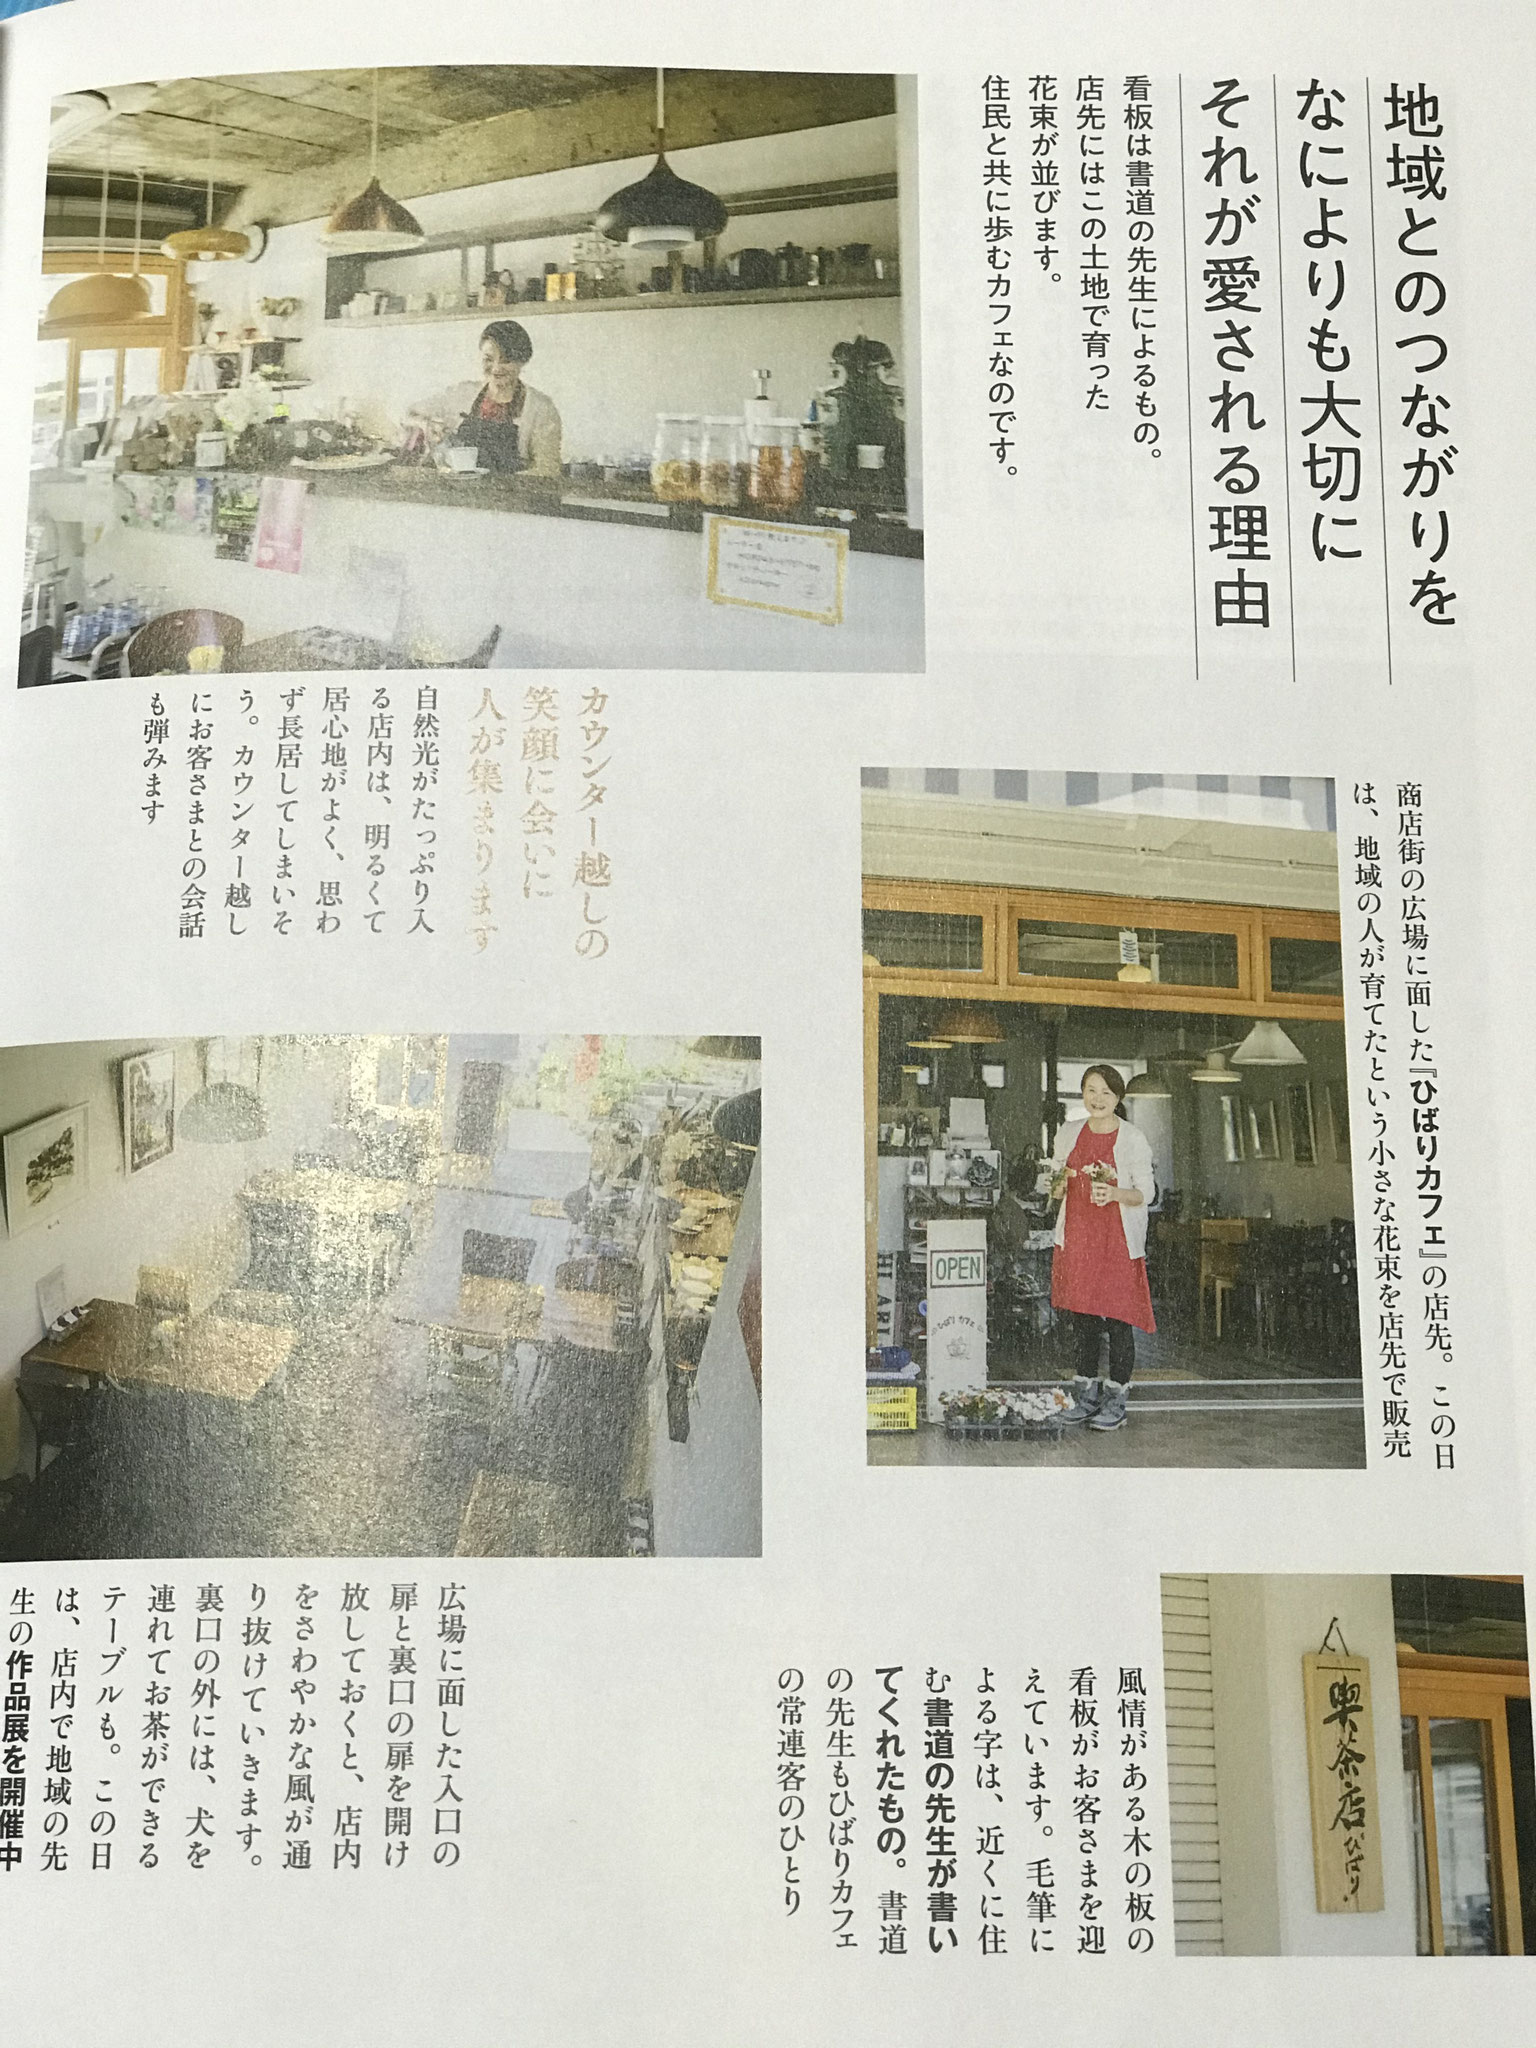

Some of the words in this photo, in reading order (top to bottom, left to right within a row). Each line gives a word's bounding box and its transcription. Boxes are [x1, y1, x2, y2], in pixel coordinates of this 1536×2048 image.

[982, 75, 1017, 475] 住民と共に歩むカフェなのです。
[1029, 75, 1061, 282] 花束が並びます。
[1076, 75, 1110, 409] 店先にはこの土地で育った
[1123, 75, 1161, 458] 看板は書道の先生によるもの。
[1297, 78, 1362, 561] なによりも大切に
[1201, 79, 1271, 628] それが愛される理由
[1384, 83, 1458, 625] 地域とのつながりを
[141, 693, 169, 824] も弾みます
[179, 694, 213, 938] にお客さまとの会話
[224, 689, 258, 935] う。カウンター越し
[271, 686, 306, 935] ず長居してしまいそ
[316, 687, 350, 933] 居心地がよく、思わ
[364, 688, 394, 933] る店内は、明るくて
[408, 685, 439, 934] 自然光がたっぷり入
[468, 688, 506, 953] 人が集まります
[521, 686, 559, 899] 笑顔に会いに
[572, 687, 611, 958] カウンター越しの
[1354, 783, 1411, 1457] は、地域の人が育てたという小さな花束を店先で販売
[1397, 782, 1455, 1469] 商店街の広場に面した『ひばりカフェ』の店先。この日
[935, 1256, 981, 1281] OPEN
[0, 1587, 35, 1871] 生の作品展を開催中
[41, 1588, 80, 1871] は、店内で地域の先
[91, 1587, 127, 1870] テーブルも。この日
[139, 1584, 176, 1868] 連れてお茶ができる
[186, 1583, 224, 1869] 裏口の外には、犬を
[236, 1583, 271, 1866] り抜けていきます。
[282, 1584, 318, 1869] をさわやかな風が通
[334, 1583, 370, 1869] 放しておくと、店内
[385, 1582, 418, 1868] 扉と裏口の扉を開け
[434, 1582, 467, 1867] 広場に面した入口の
[777, 1669, 806, 1916] の常連客のひとり
[826, 1669, 858, 1948] の先生もひばりカフェ
[875, 1666, 907, 1954] てくれたもの。書道
[924, 1667, 958, 1953] む書道の先生が書い
[974, 1667, 1007, 1955] よる字は、近くに住
[1024, 1668, 1056, 1952] えています。毛筆に
[1069, 1666, 1106, 1954] 看板がお客さまを迎
[1117, 1667, 1155, 1953] 風情がある木の板の
